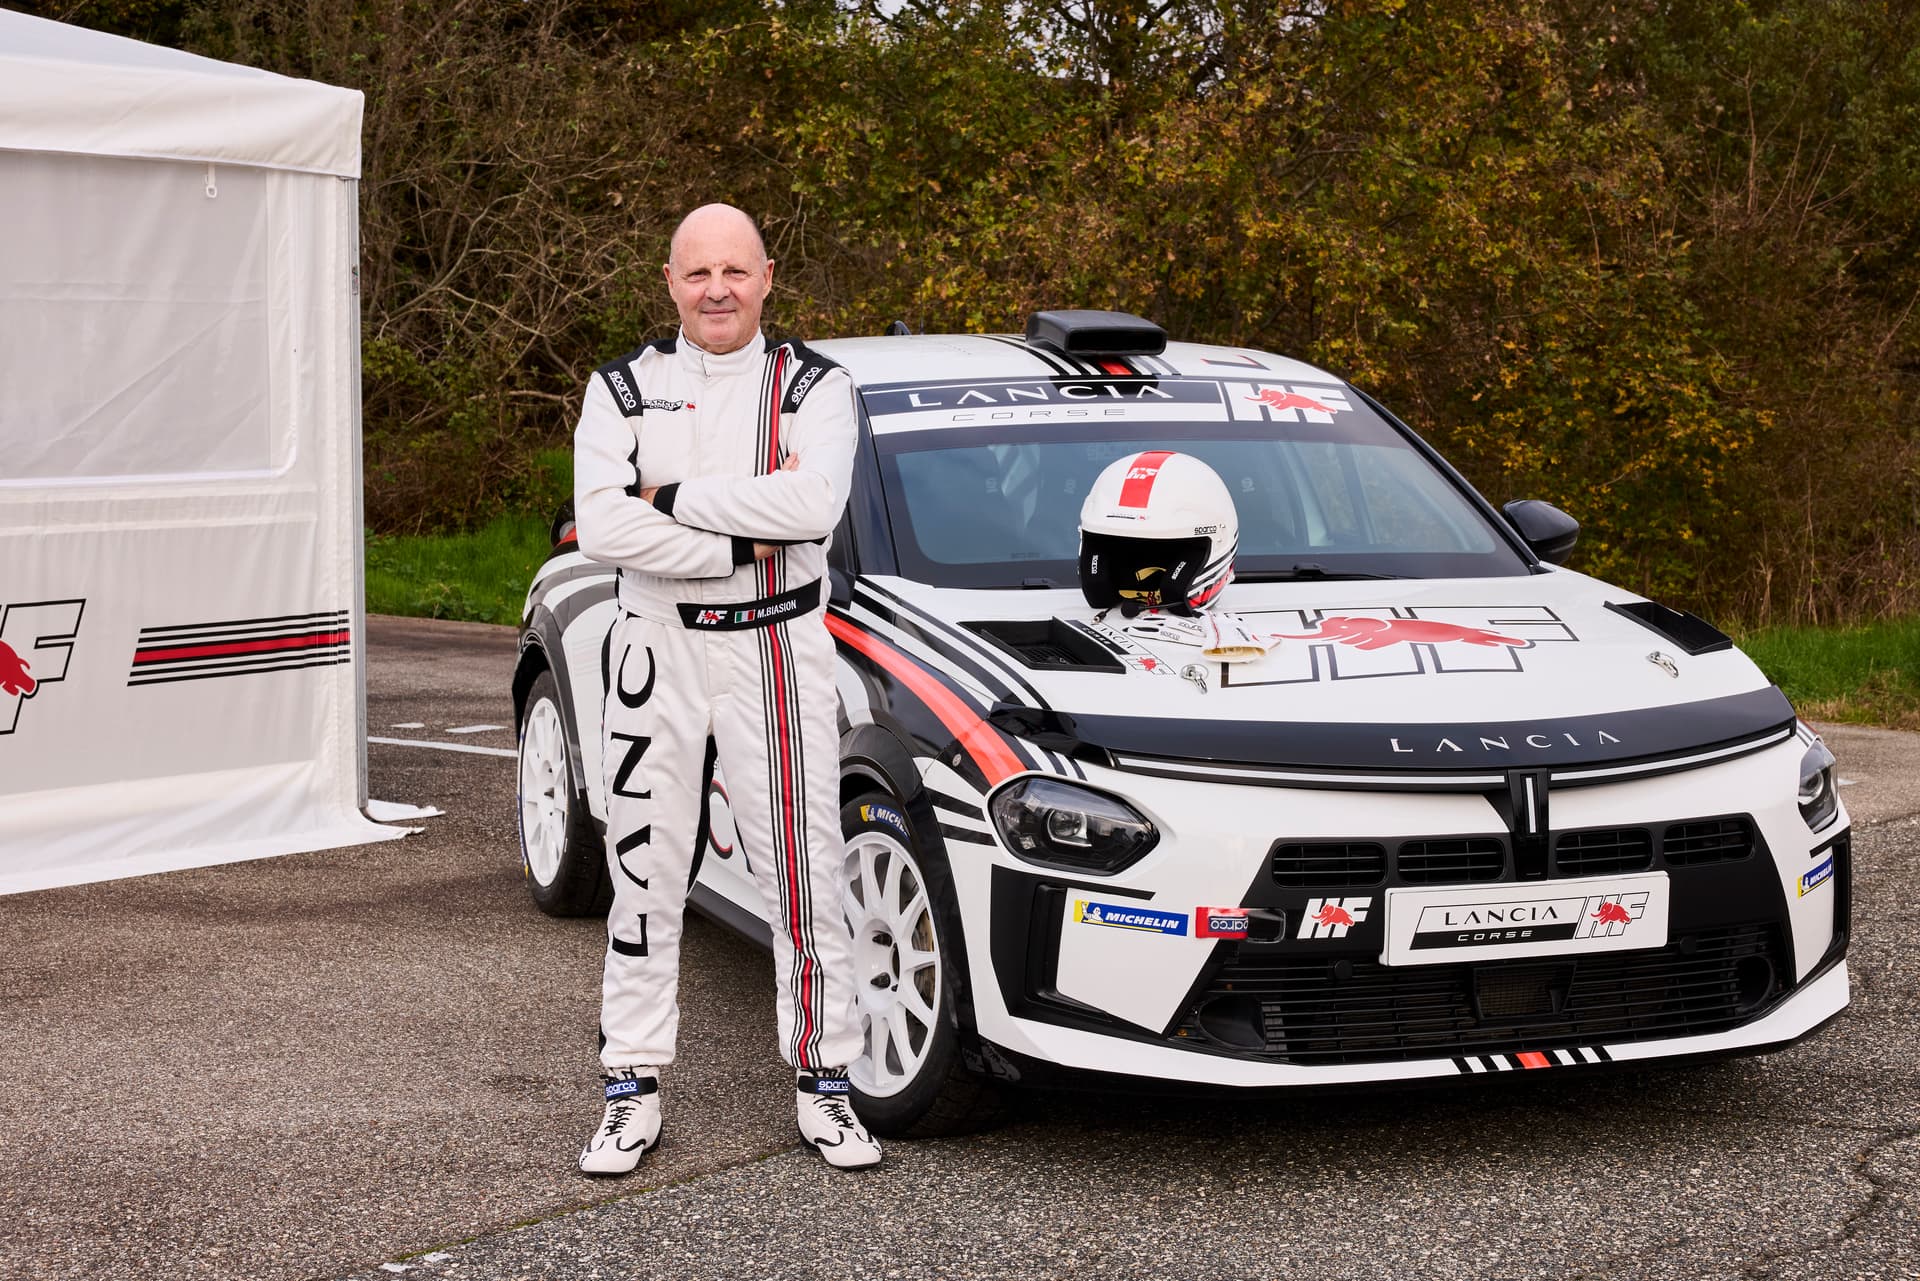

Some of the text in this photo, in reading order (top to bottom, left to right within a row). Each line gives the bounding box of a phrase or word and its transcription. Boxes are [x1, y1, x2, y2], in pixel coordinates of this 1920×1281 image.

[791, 366, 821, 404] sparco
[908, 385, 1174, 408] LANCIA
[952, 408, 1126, 422] CORSE
[1194, 525, 1218, 535] sparco
[757, 599, 797, 619] M.BIASION
[1390, 730, 1621, 753] LANCIA
[610, 630, 656, 958] LANC
[1105, 911, 1180, 929] MICHELIN
[1444, 905, 1559, 926] LANCIA
[1457, 930, 1534, 942] CORSE
[818, 1080, 849, 1092] sparc
